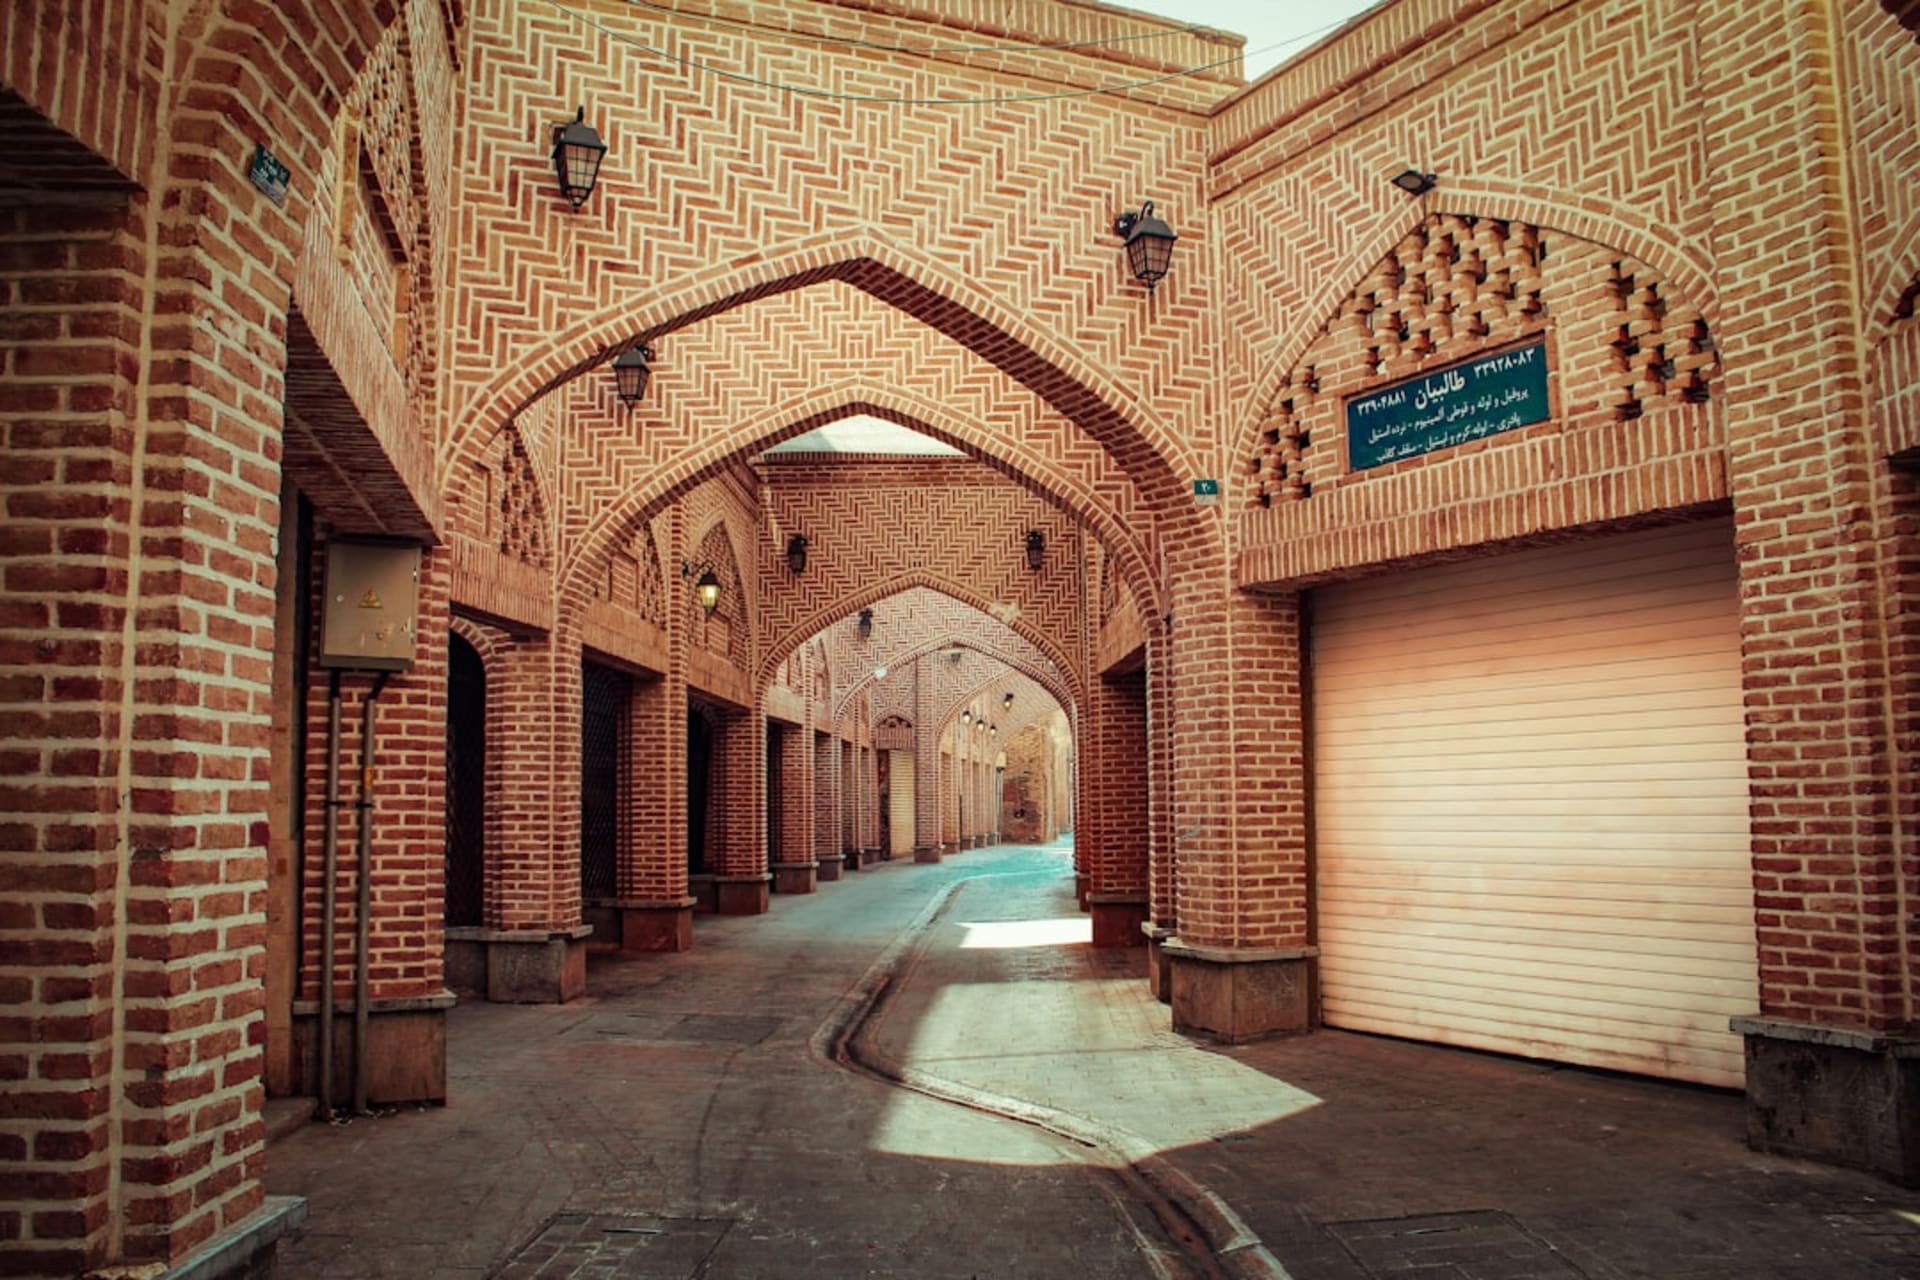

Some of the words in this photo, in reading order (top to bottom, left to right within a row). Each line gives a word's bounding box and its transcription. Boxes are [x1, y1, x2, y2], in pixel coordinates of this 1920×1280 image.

[1415, 369, 1466, 410] طالبیان
[1500, 387, 1529, 406] پروفیل
[1470, 405, 1476, 415] و
[1477, 394, 1492, 411] لوله
[1494, 398, 1500, 408] و
[1446, 401, 1469, 422] قوطی
[1473, 420, 1488, 437] لوله
